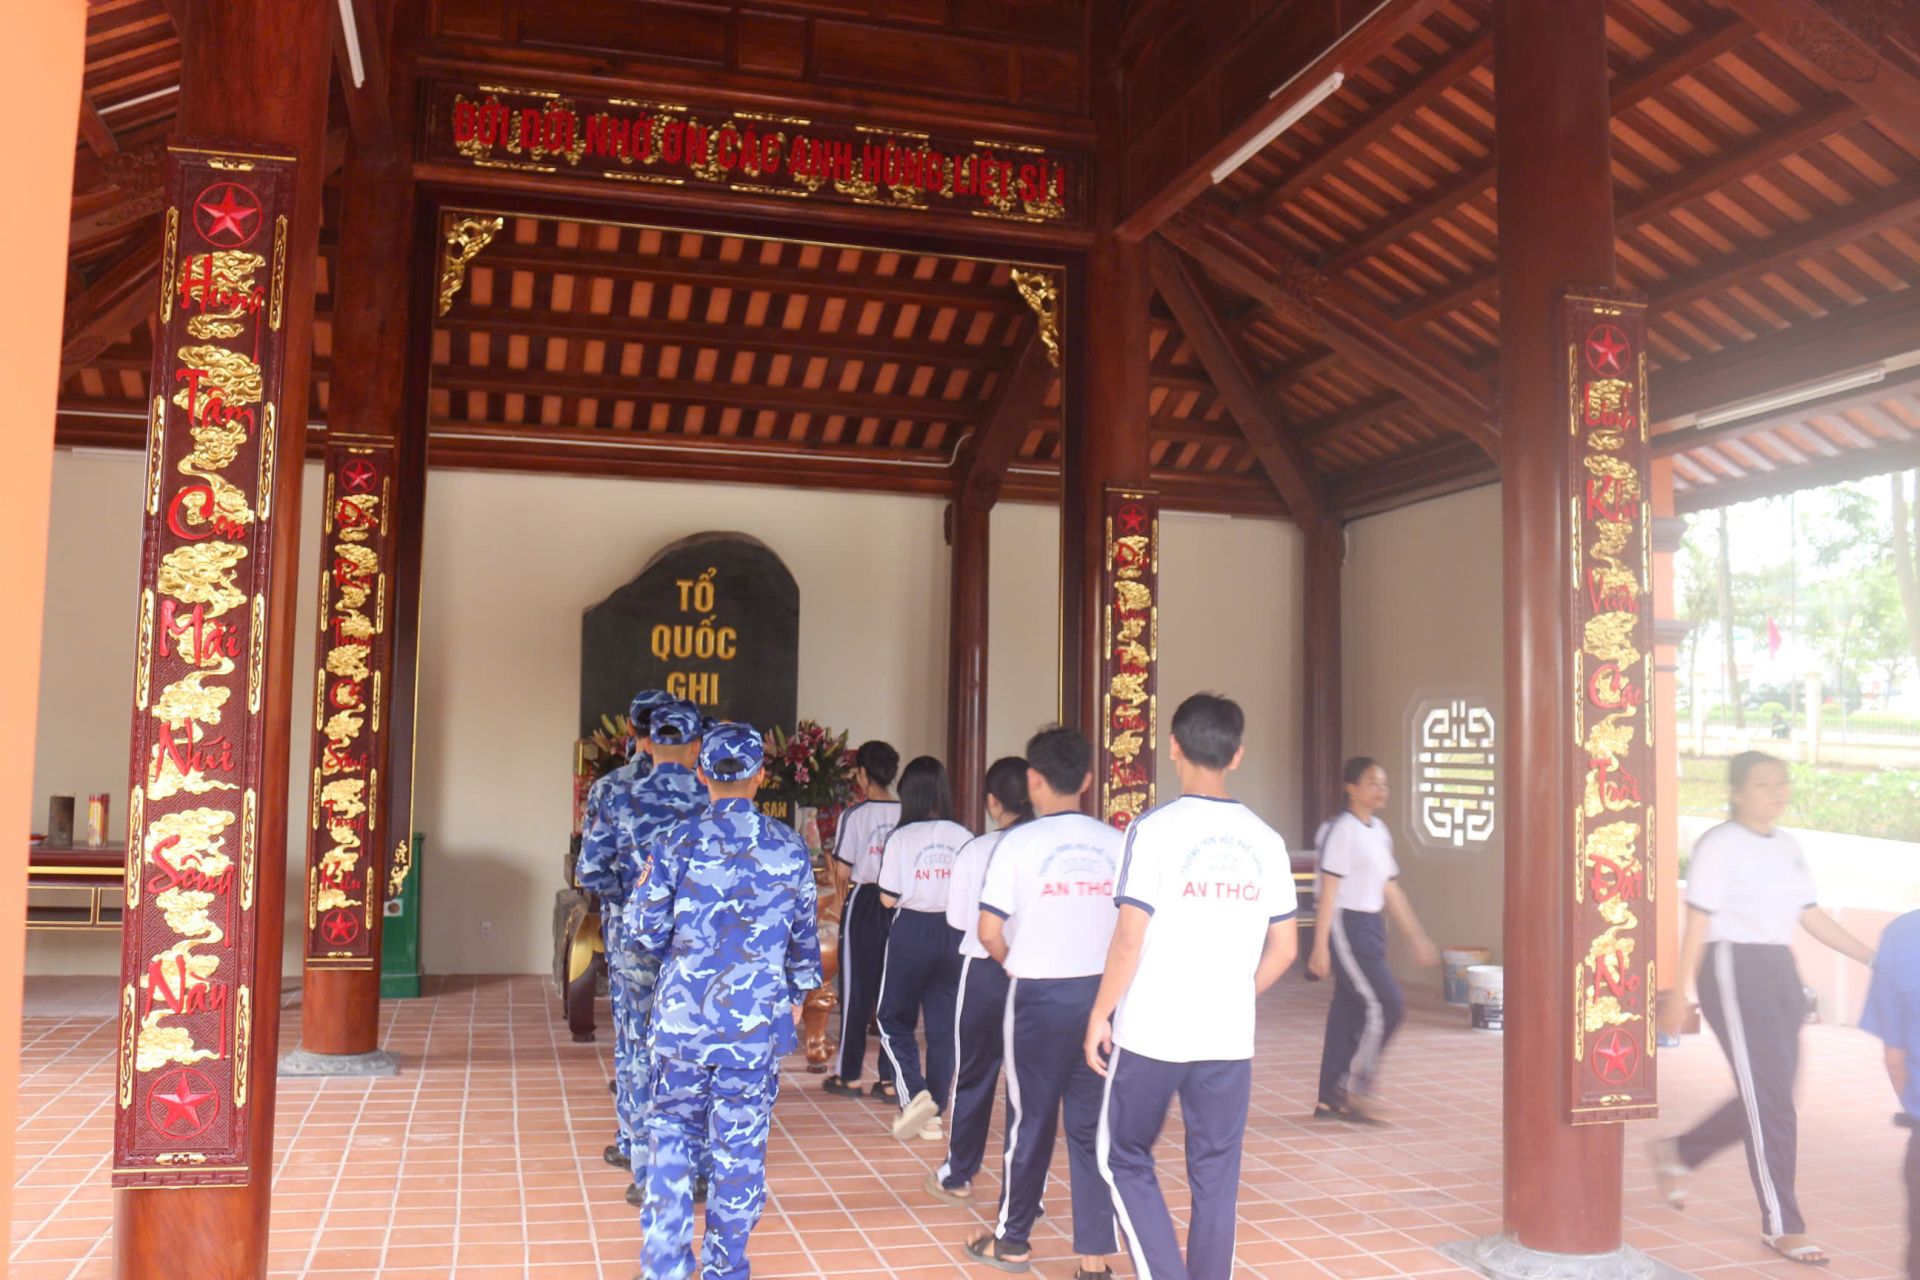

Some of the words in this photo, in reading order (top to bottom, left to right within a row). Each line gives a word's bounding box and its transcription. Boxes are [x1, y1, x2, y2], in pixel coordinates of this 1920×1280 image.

[454, 96, 511, 147] ĐỜI
[521, 101, 576, 152] ĐỜI
[586, 112, 656, 161] NHỚ
[662, 119, 706, 165] ƠN
[719, 123, 781, 173] CÁC
[788, 135, 852, 182] ANH
[862, 139, 945, 193] HÙNG
[953, 150, 1013, 206] LIỆT
[177, 254, 265, 366] Hùng
[176, 369, 255, 434] Tâm
[1584, 382, 1637, 431] Linh
[167, 485, 246, 541] Còn
[676, 567, 717, 613] TỔ
[651, 614, 738, 662] QUỐC
[666, 671, 720, 706] GHI
[153, 717, 236, 783] Núi
[147, 834, 236, 948] Sông
[915, 869, 931, 881] AN
[1040, 882, 1071, 897] AN
[1182, 881, 1208, 898] AN
[1589, 853, 1643, 903] Đất
[1593, 950, 1640, 1005] Nọ
[143, 954, 229, 1061] Này
